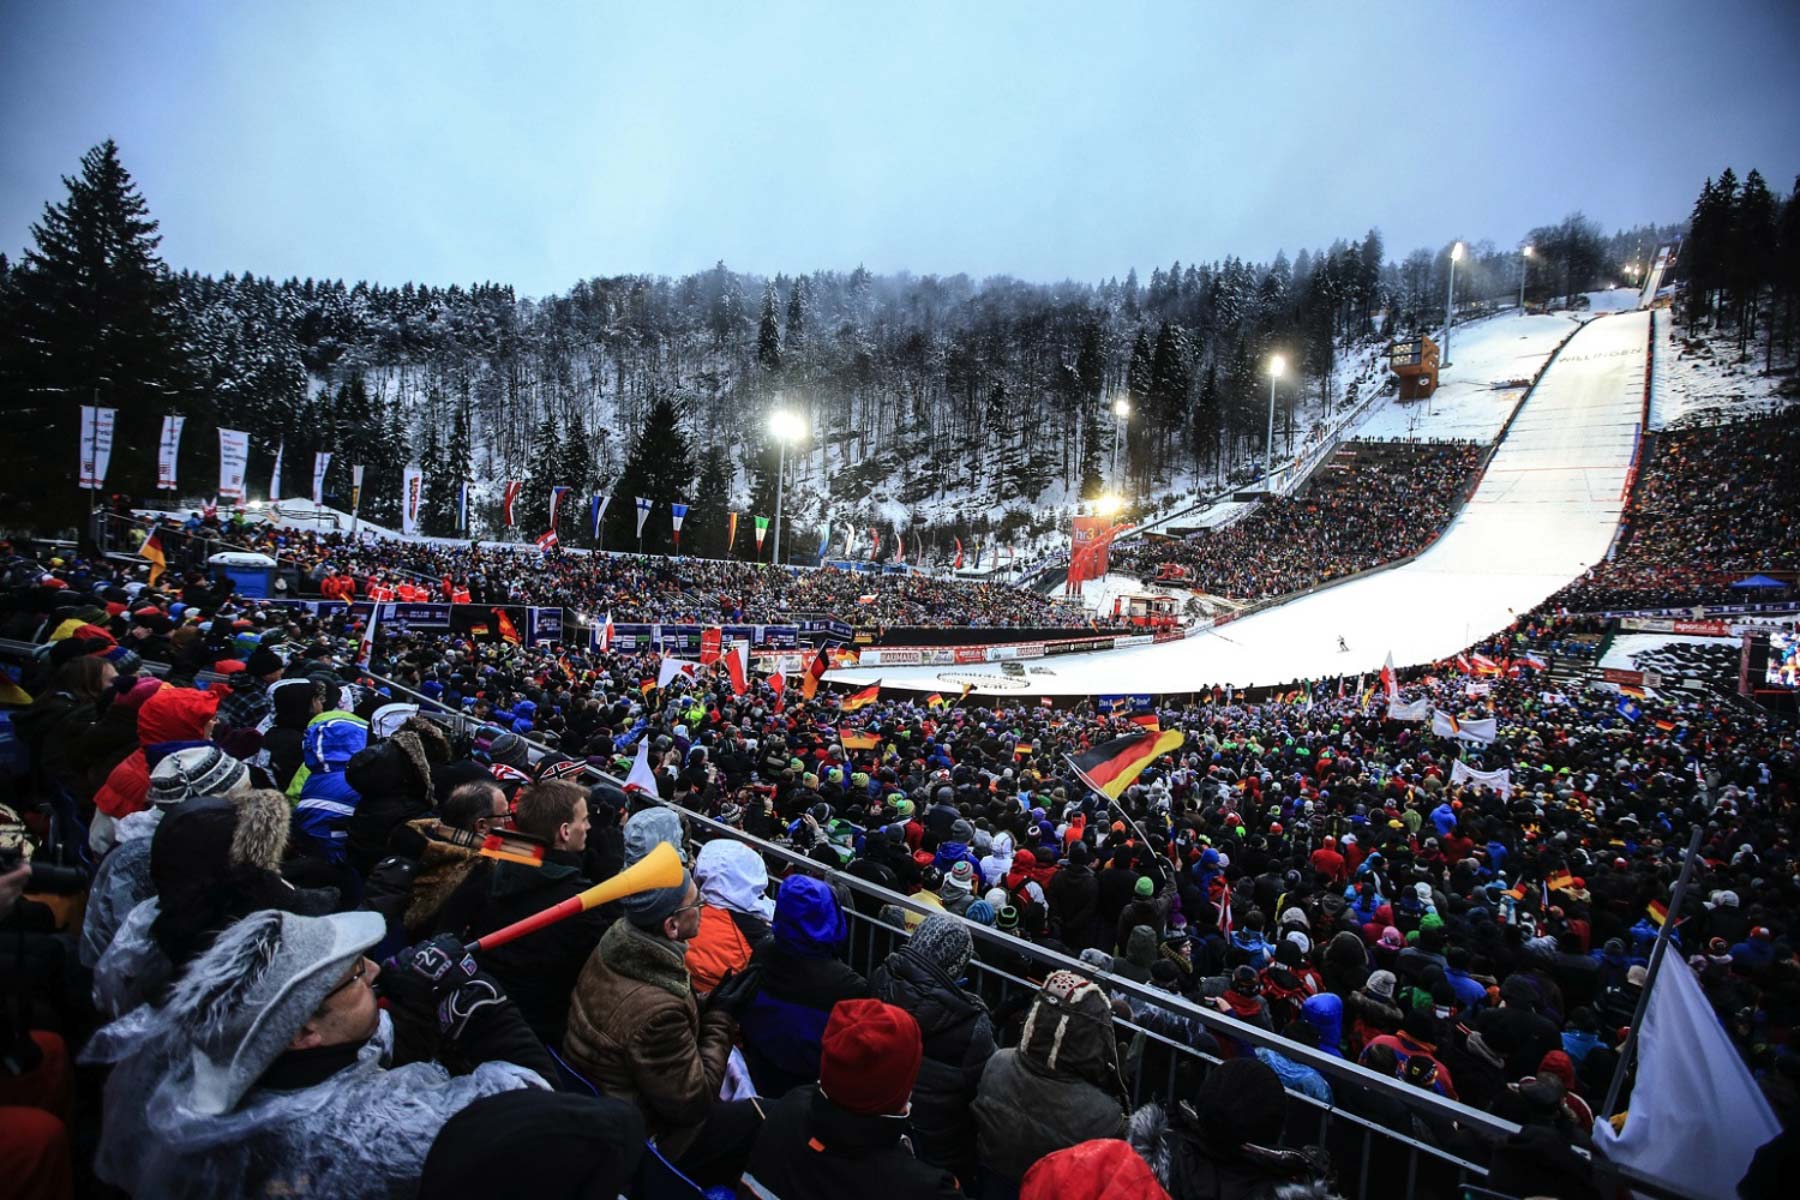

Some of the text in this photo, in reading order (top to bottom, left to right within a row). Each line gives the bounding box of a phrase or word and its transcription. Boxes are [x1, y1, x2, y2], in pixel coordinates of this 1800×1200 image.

[1559, 348, 1642, 362] WILLINGEN
[1076, 527, 1095, 541] hr3
[1675, 623, 1719, 632] apotal.de
[880, 652, 919, 663] BAUHAUS
